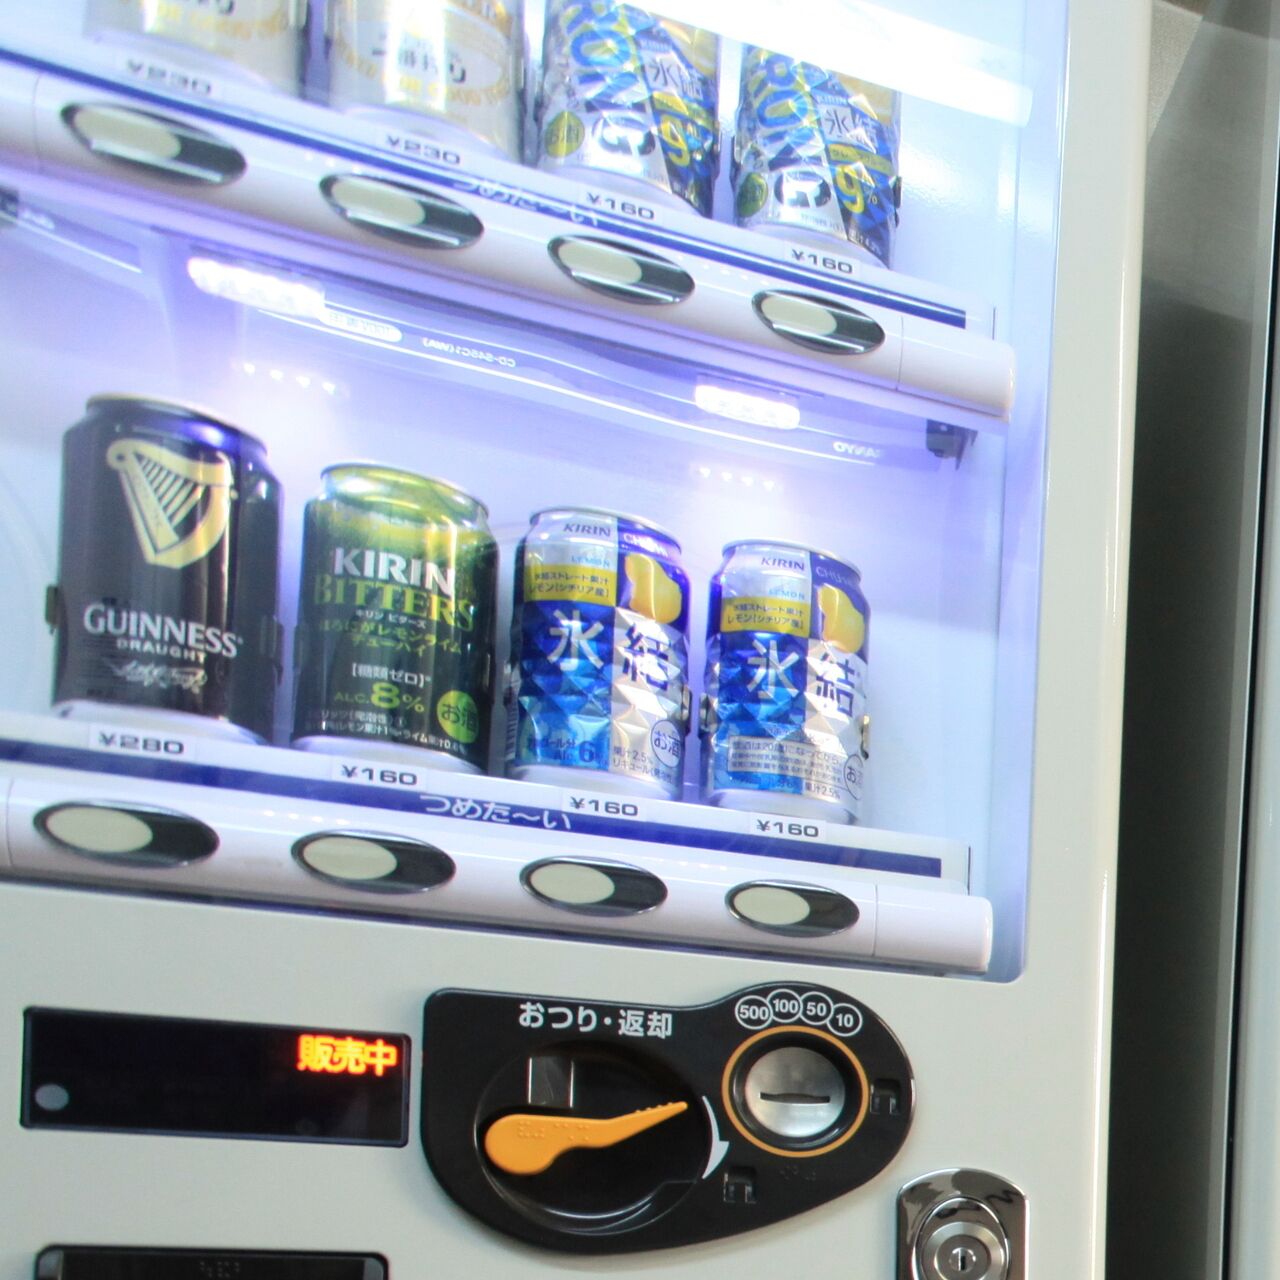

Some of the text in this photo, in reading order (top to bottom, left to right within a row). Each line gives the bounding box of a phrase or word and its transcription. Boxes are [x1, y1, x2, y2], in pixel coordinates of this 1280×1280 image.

[126, 58, 212, 96] ¥230
[386, 134, 461, 165] ¥230
[586, 190, 655, 221] ¥160
[791, 247, 853, 275] ¥160
[562, 522, 611, 538] KIRIN
[334, 547, 455, 595] KIRIN
[761, 556, 805, 572] KIRIN
[315, 574, 474, 632] BITTERS
[84, 604, 238, 658] GUINNESS
[117, 639, 206, 663] DRAUGHT
[547, 609, 671, 691] 氷結
[747, 639, 856, 718] 氷結
[99, 732, 185, 755] ¥280
[341, 763, 418, 785] ¥160
[570, 796, 639, 817] ¥160
[756, 819, 819, 838] ¥160
[519, 1003, 673, 1039] おつり・返却
[739, 999, 853, 1028] 500 100 50 10
[297, 1033, 399, 1076] 販売中
